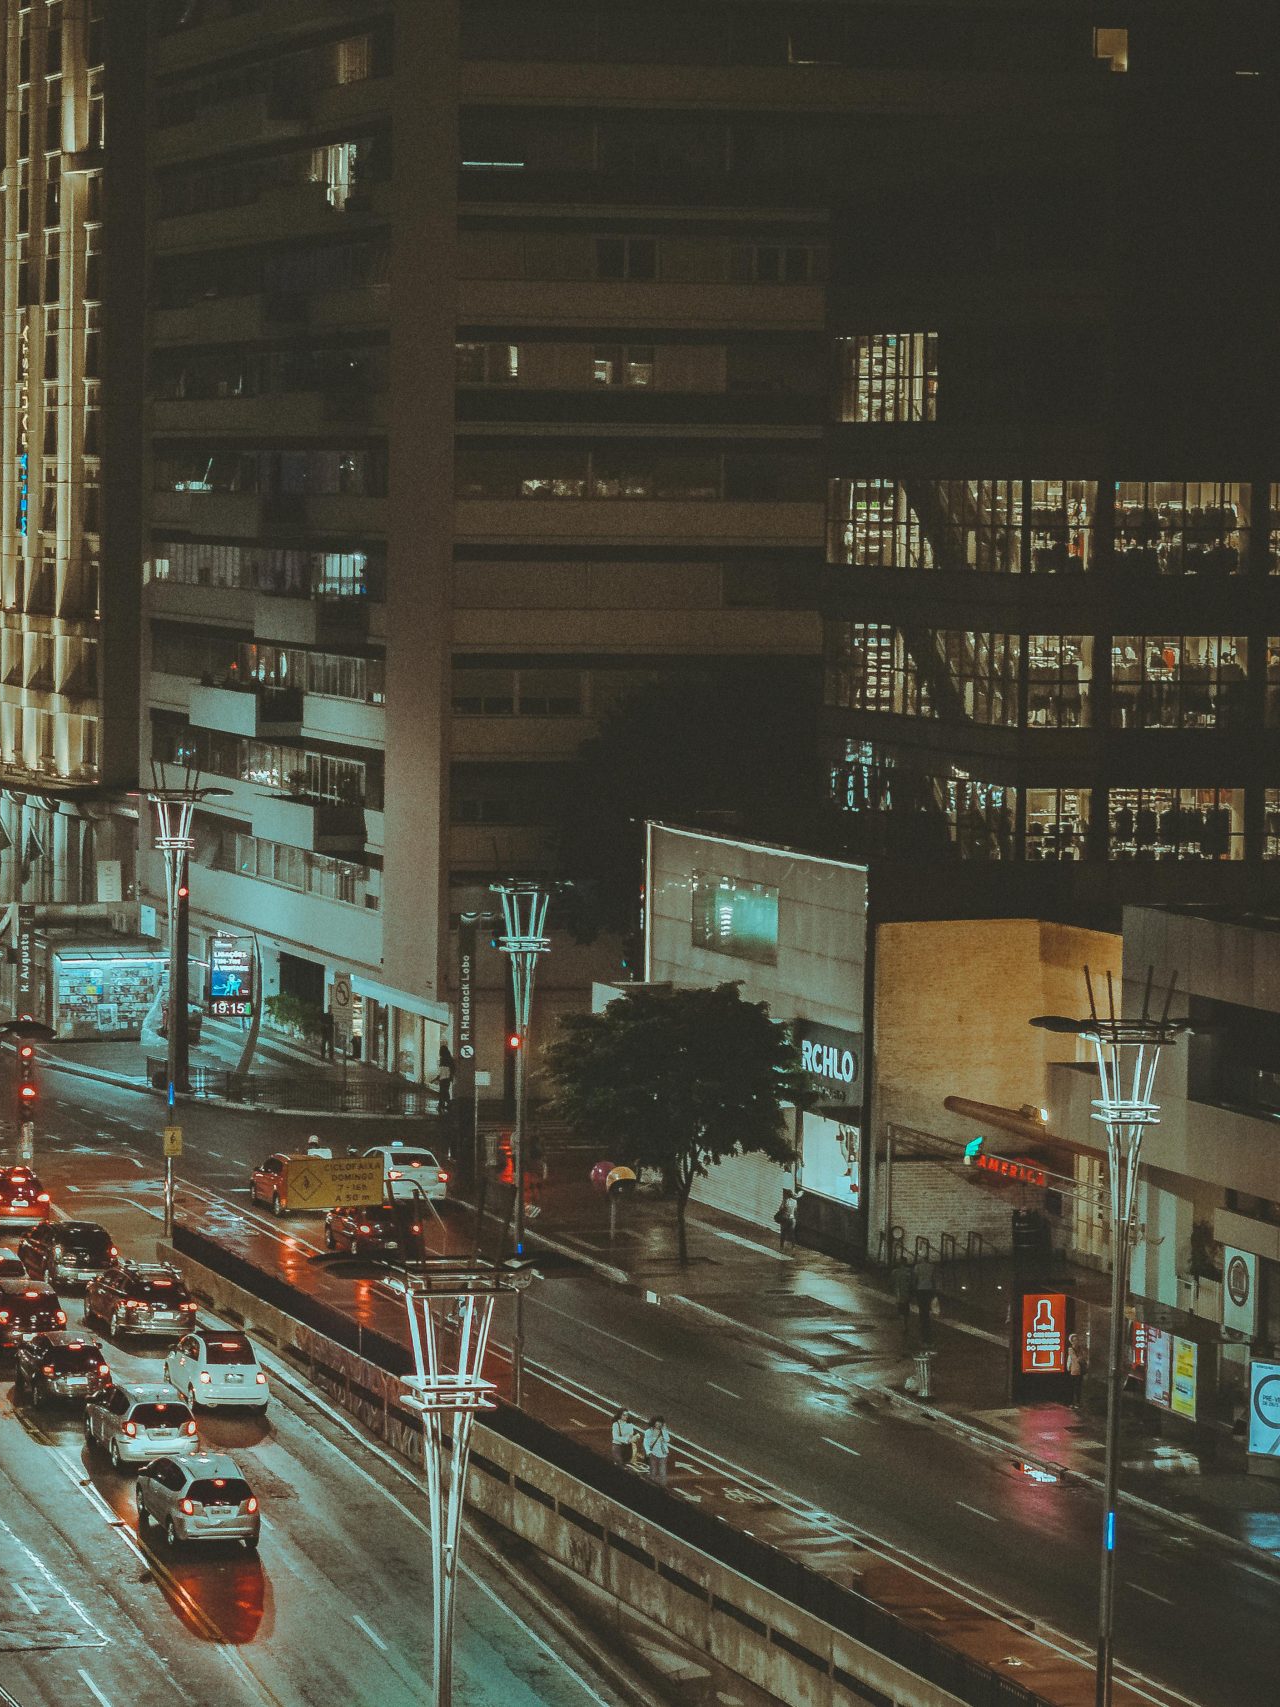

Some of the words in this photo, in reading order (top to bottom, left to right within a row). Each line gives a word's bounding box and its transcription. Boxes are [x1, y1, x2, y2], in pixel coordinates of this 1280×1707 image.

[21, 325, 29, 446] PAULISTA
[20, 933, 32, 979] Augusta
[462, 954, 470, 981] Lobo
[211, 1002, 245, 1014] 19:15
[461, 983, 470, 1029] Haddock
[461, 1030, 470, 1041] R.
[801, 1040, 854, 1083] RCHLO
[331, 1172, 374, 1182] DOMINGO
